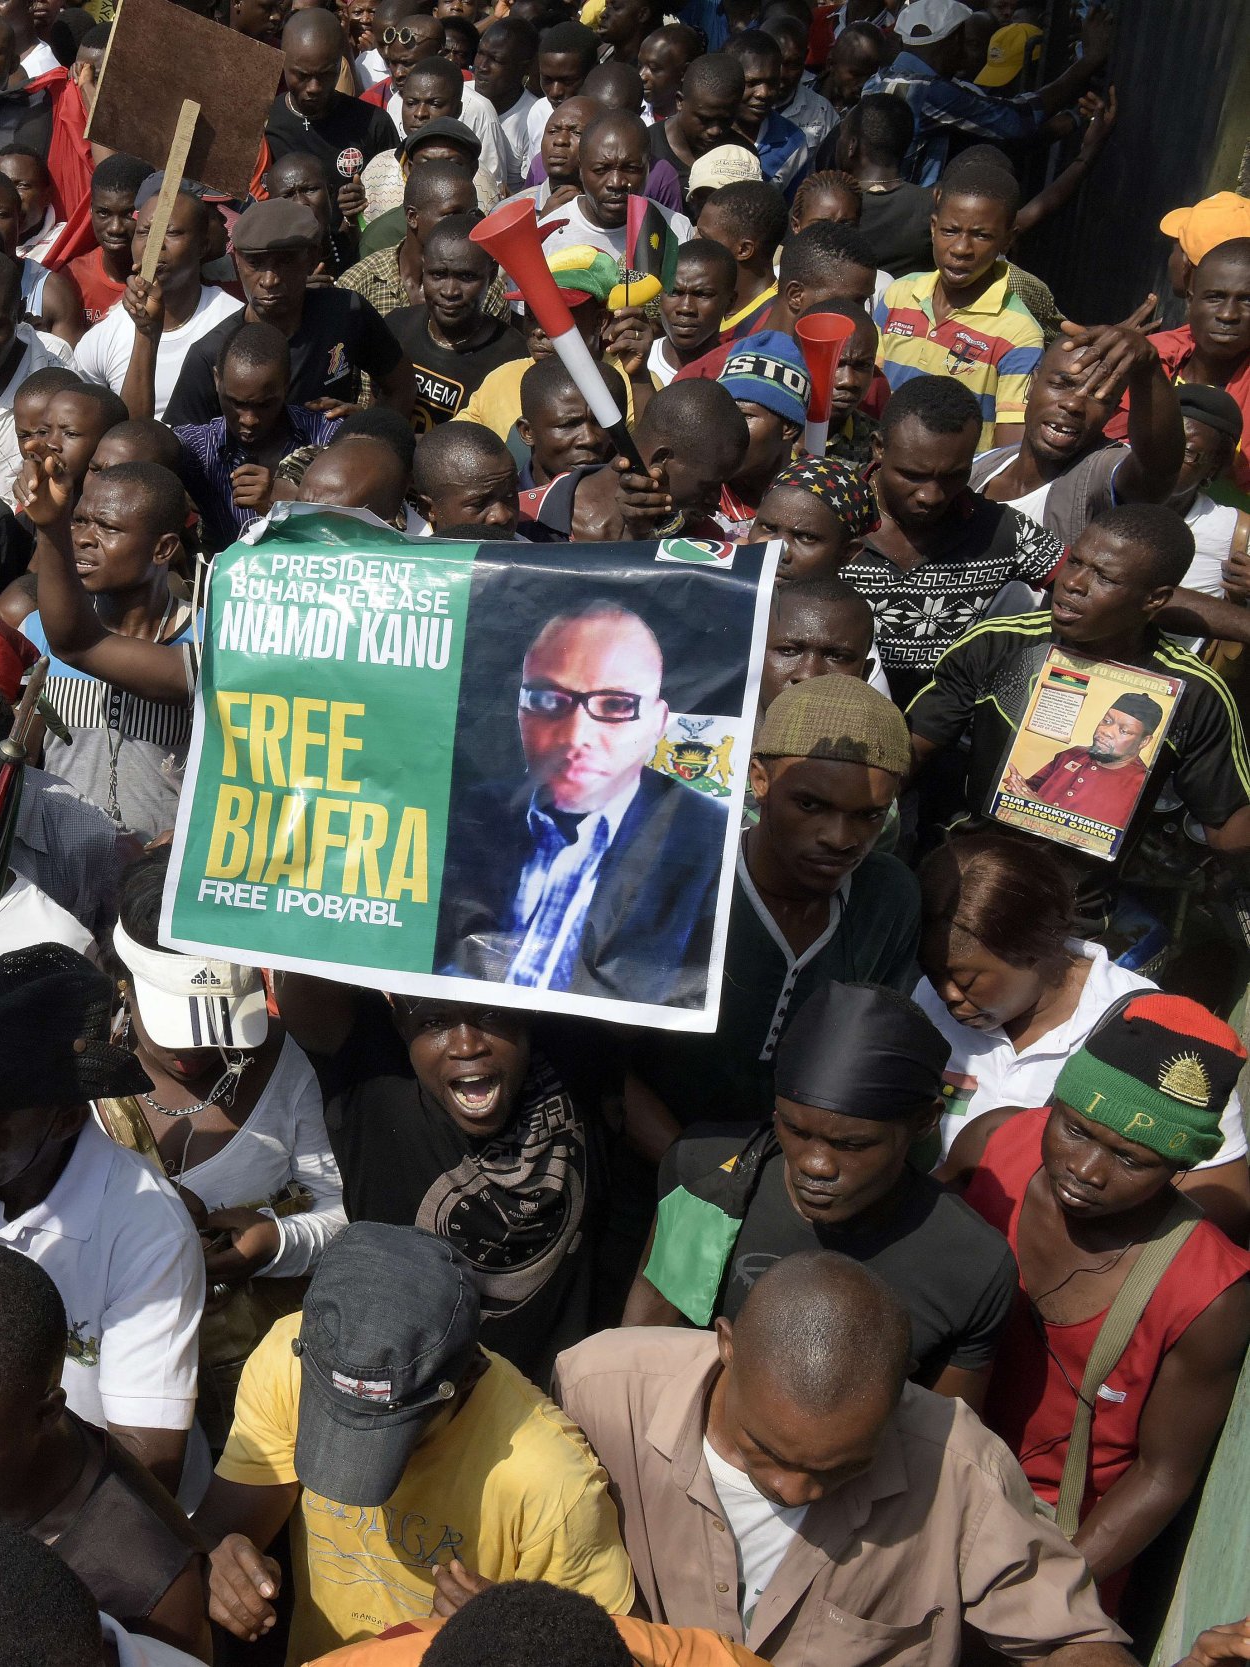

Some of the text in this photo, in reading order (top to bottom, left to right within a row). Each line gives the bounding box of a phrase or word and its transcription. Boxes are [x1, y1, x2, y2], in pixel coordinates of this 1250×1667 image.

[716, 355, 811, 403] STO
[271, 554, 415, 586] PRESIDENT
[230, 576, 450, 615] BUHARI RELEASE
[218, 601, 453, 671] NNAMDI KANU
[216, 690, 365, 793] FREE
[999, 801, 1116, 842] ODUMEGWU OJUKWU
[1001, 794, 1117, 836] DIM CHUKWUEMEKA
[205, 783, 428, 903] BIAFRA
[197, 879, 402, 927] FREE IPOB/RBL
